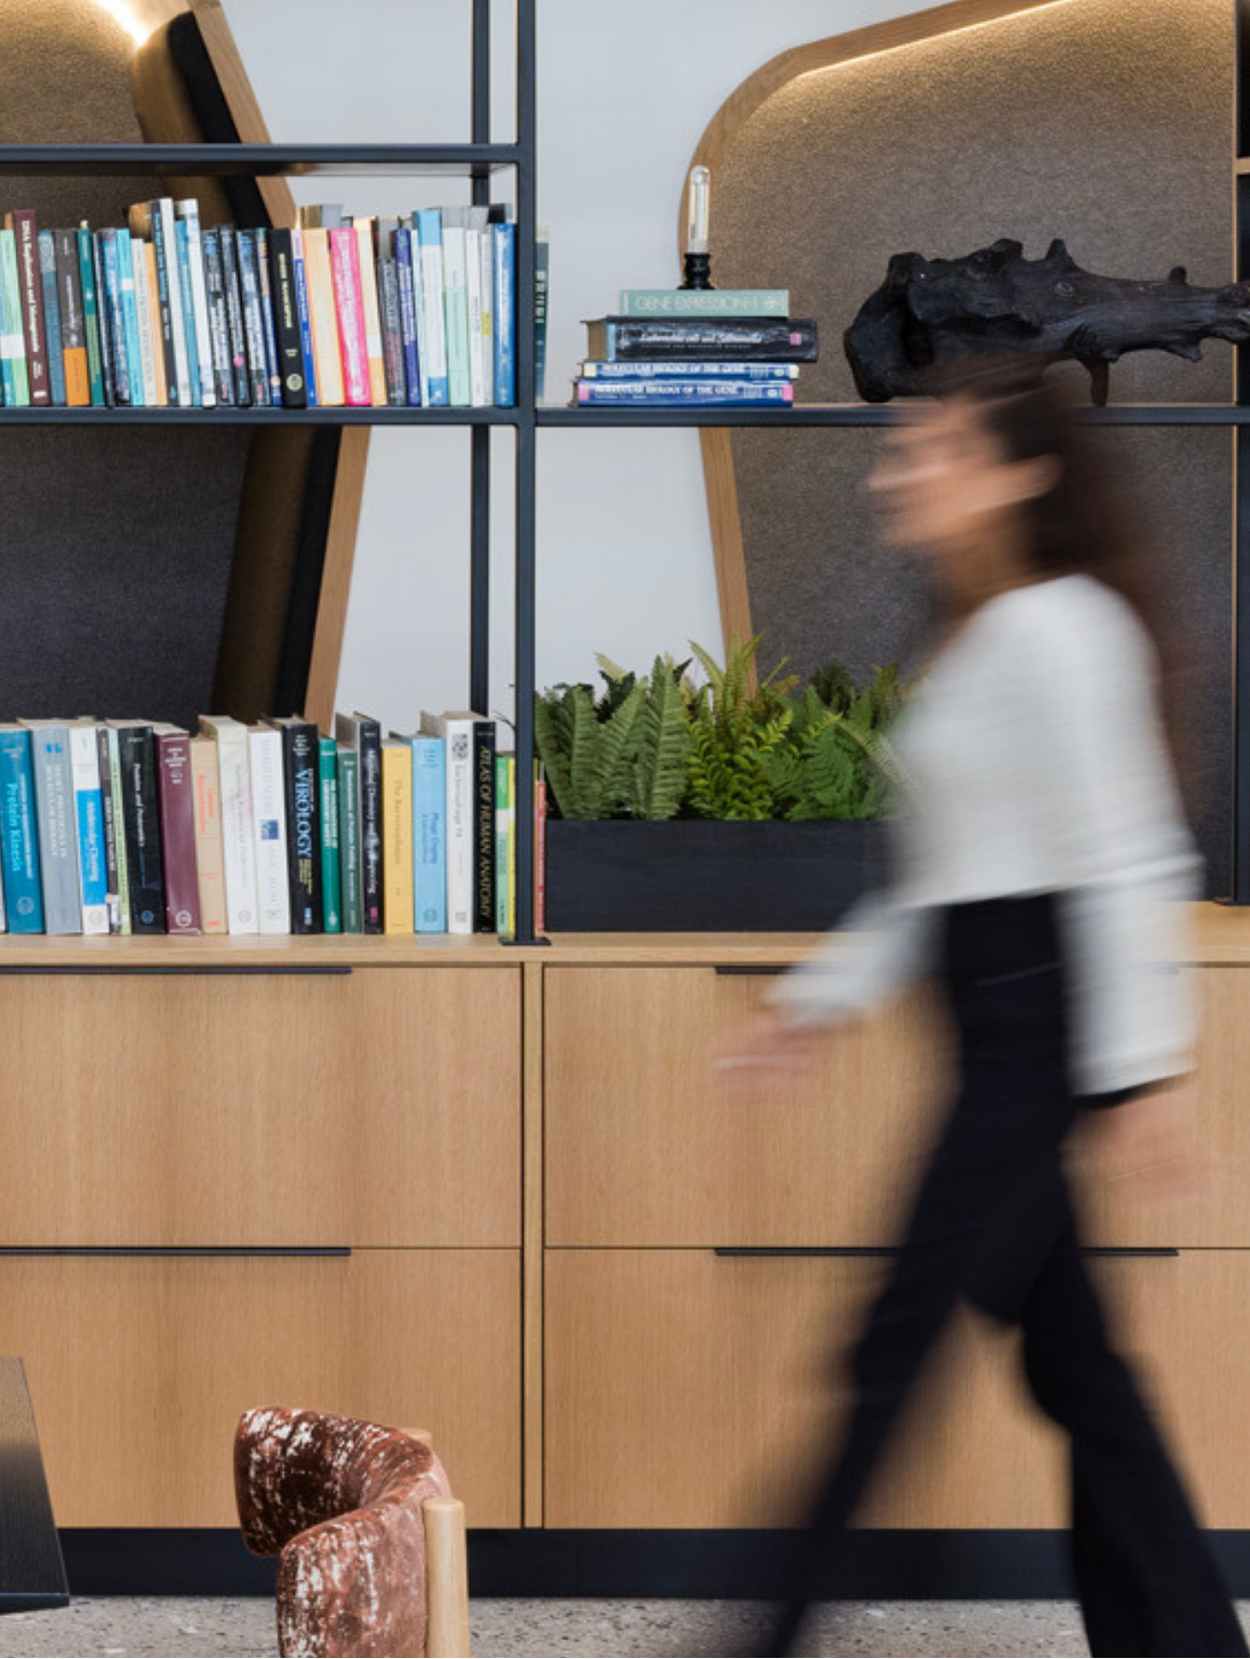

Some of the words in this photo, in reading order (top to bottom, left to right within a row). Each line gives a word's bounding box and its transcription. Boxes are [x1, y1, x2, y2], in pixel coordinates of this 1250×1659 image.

[21, 220, 31, 240] DNA
[22, 242, 35, 286] Replication
[26, 289, 36, 303] and
[635, 294, 672, 310] GENE
[27, 304, 40, 352] Mutagenesis
[595, 385, 643, 395] MOLECULAR
[646, 385, 678, 395] BIOLOGY
[682, 385, 694, 395] OF
[697, 385, 711, 395] THE
[714, 385, 739, 395] GENE
[54, 764, 64, 791] SHORT
[133, 763, 143, 790] Proteins
[367, 750, 376, 783] Microbial
[480, 746, 491, 781] ATLAS
[5, 782, 20, 826] Protein
[46, 764, 56, 816] MOLECULAR
[134, 792, 143, 806] and
[345, 770, 353, 809] Mechanisms
[367, 788, 376, 819] Diversity
[394, 779, 402, 796] The
[480, 785, 491, 801] OF
[56, 794, 66, 842] PROTOCOLS
[86, 800, 97, 844] Molecular
[137, 808, 147, 846] Proteomics
[294, 770, 312, 857] VIROLOGY
[368, 821, 376, 834] and
[430, 813, 438, 834] Phage
[480, 805, 491, 853] HUMAN
[8, 829, 23, 871] Kinesis
[48, 819, 58, 856] BIOLOGY
[58, 845, 67, 857] IN
[430, 837, 438, 863] Display
[87, 847, 100, 882] Cloning
[347, 846, 355, 869] Folding
[480, 857, 491, 917] ANATOMY
